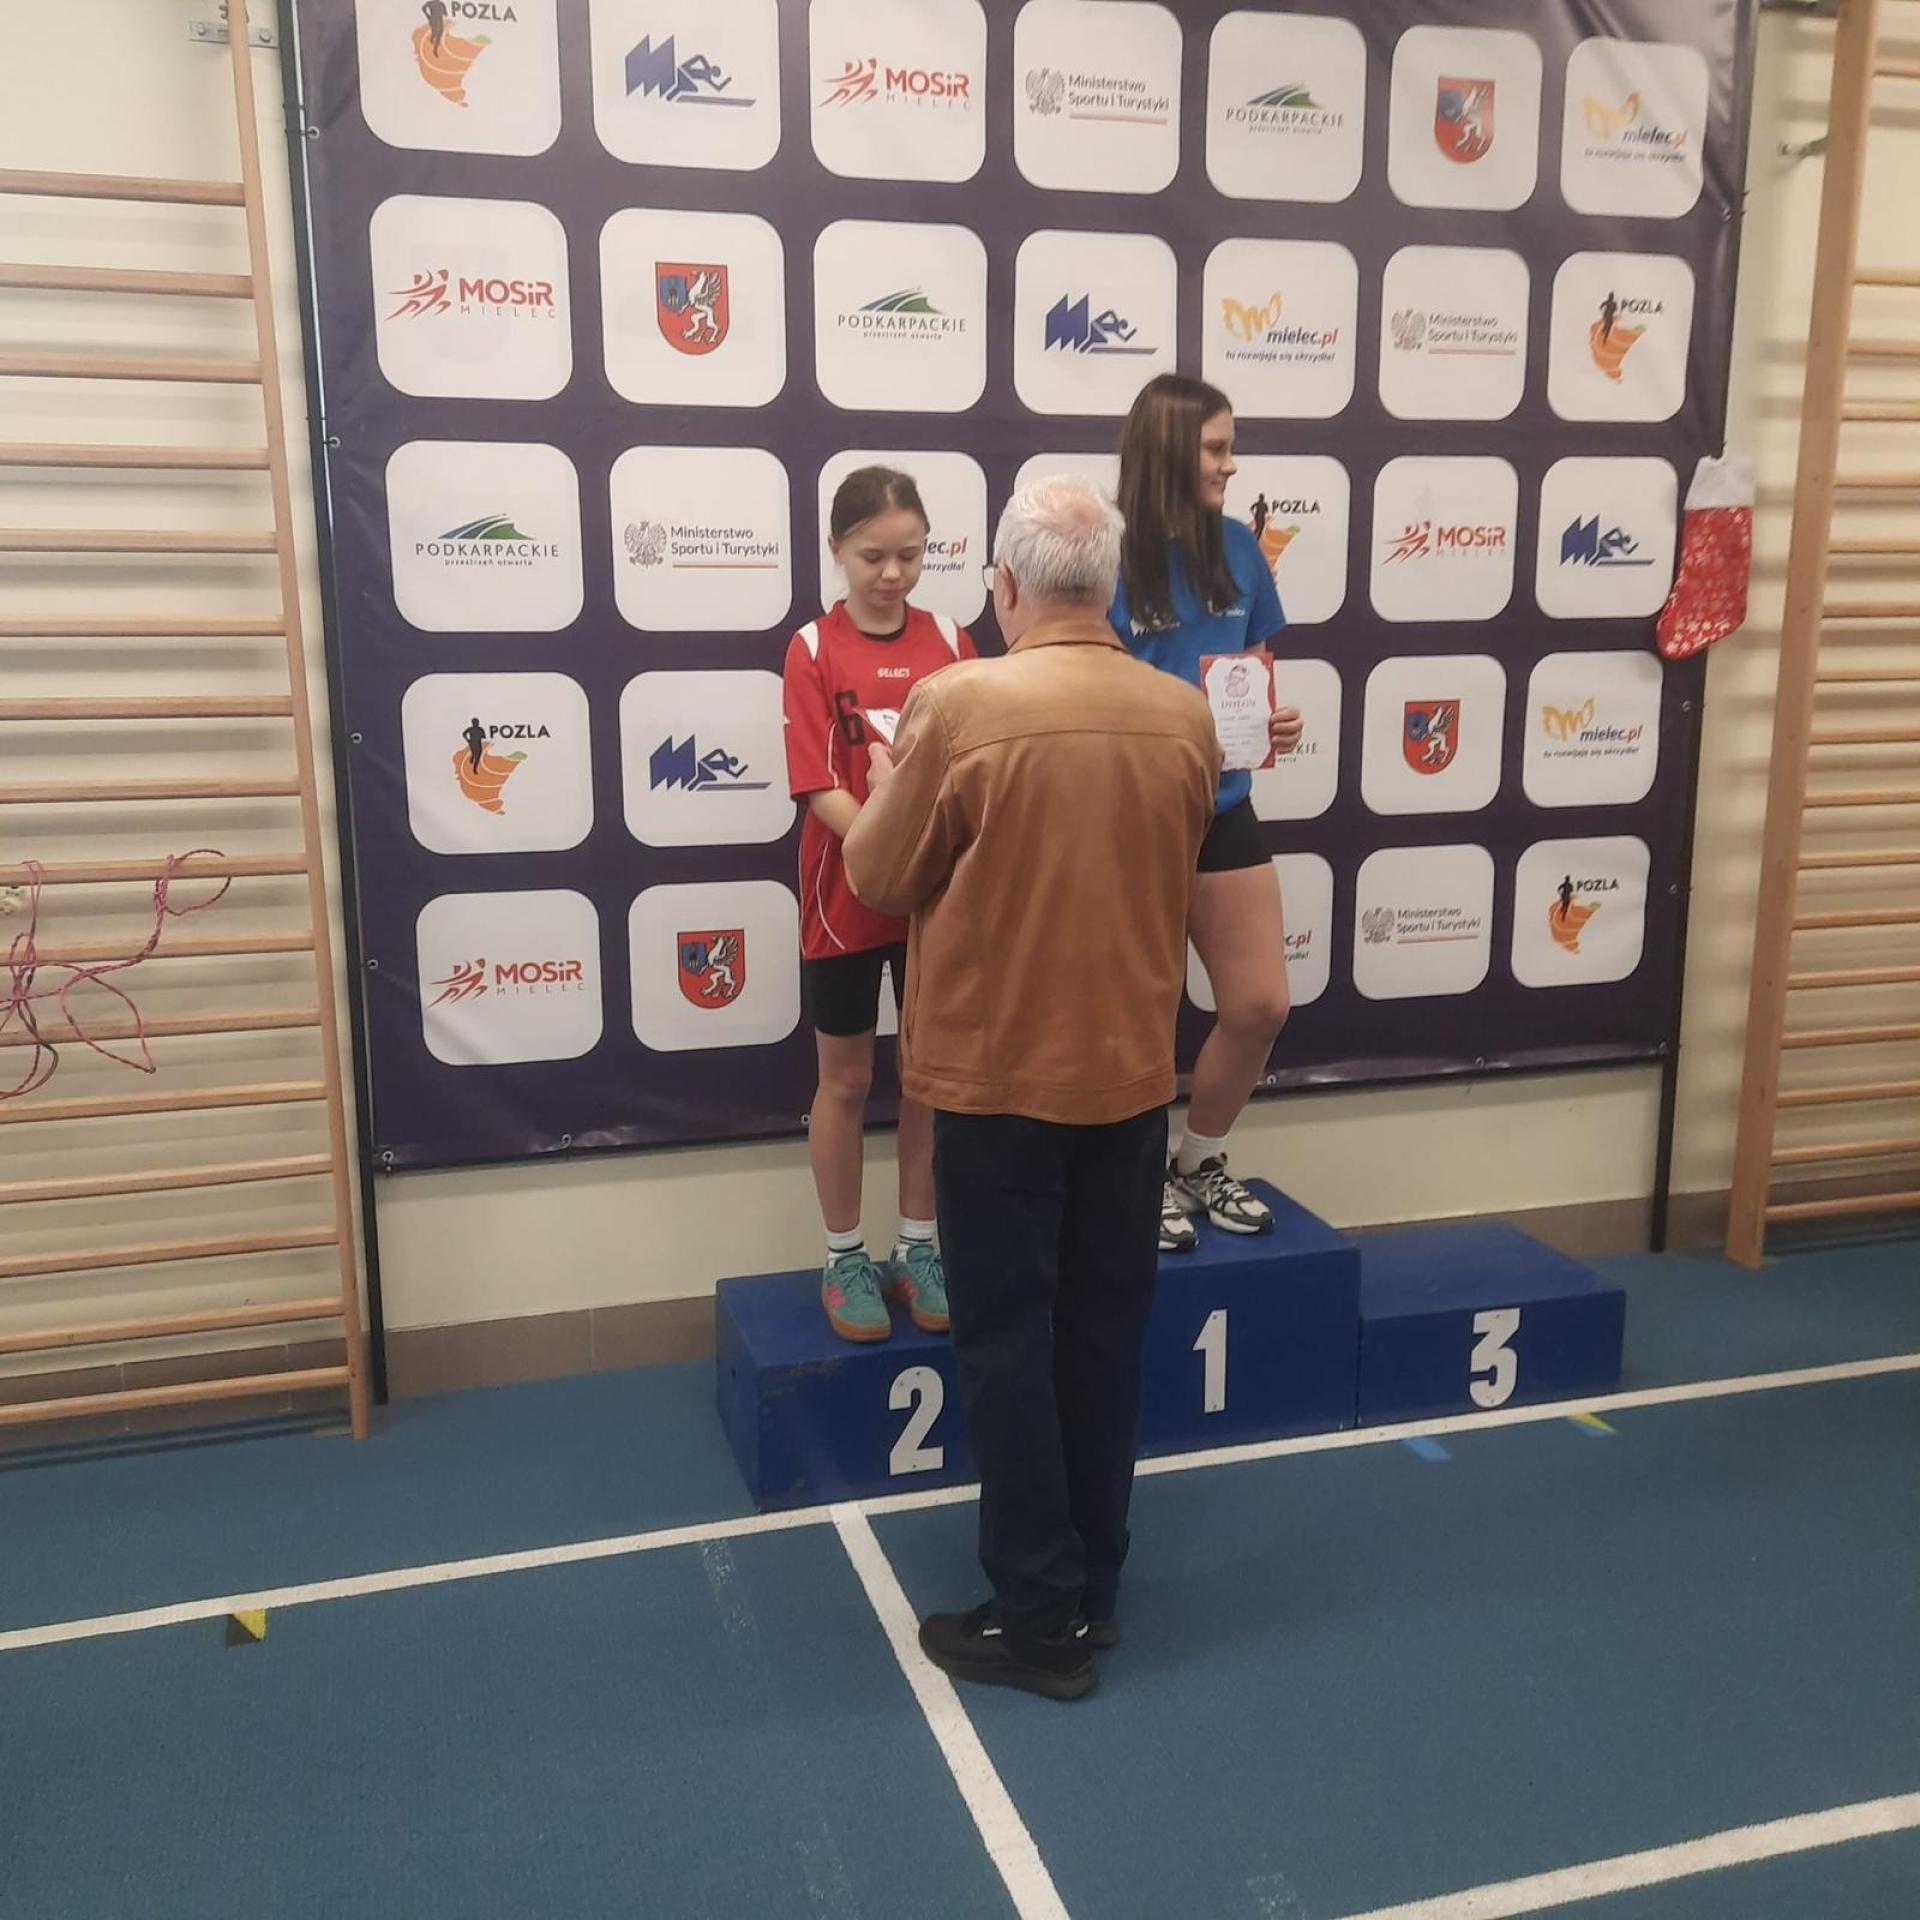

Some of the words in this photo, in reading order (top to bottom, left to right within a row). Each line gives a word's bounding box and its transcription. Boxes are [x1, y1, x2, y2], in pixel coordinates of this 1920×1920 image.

[451, 1, 518, 22] POZLA
[885, 67, 970, 98] MOSiR
[1068, 74, 1146, 93] Ministerstwo
[1068, 92, 1108, 109] Sportu
[1119, 94, 1169, 113] Turystyki
[1225, 108, 1343, 128] PODKARPACKIE
[459, 277, 554, 306] MOSiR
[460, 305, 556, 319] MIELEC
[1619, 298, 1664, 314] POZLA
[838, 314, 967, 332] PODKARPACKIE
[1266, 326, 1338, 349] mielec.pl
[1271, 499, 1321, 514] POZLA
[671, 525, 754, 539] Ministerstwo
[1437, 526, 1506, 548] MOSiR
[415, 543, 560, 558] PODKARPACKIE
[671, 542, 713, 557] Sportu
[721, 542, 779, 557] Turystyki
[923, 537, 967, 558] lec.pl
[877, 667, 910, 678] SELECT
[835, 689, 865, 746] 6
[489, 724, 551, 739] POZLA
[1580, 724, 1643, 743] mielec.pl
[1576, 878, 1618, 892] POZLA
[495, 960, 582, 984] MOSiR
[496, 981, 585, 996] MIELEC
[1192, 1309, 1228, 1414] 1
[1469, 1307, 1521, 1408] 3
[888, 1365, 944, 1476] 2
